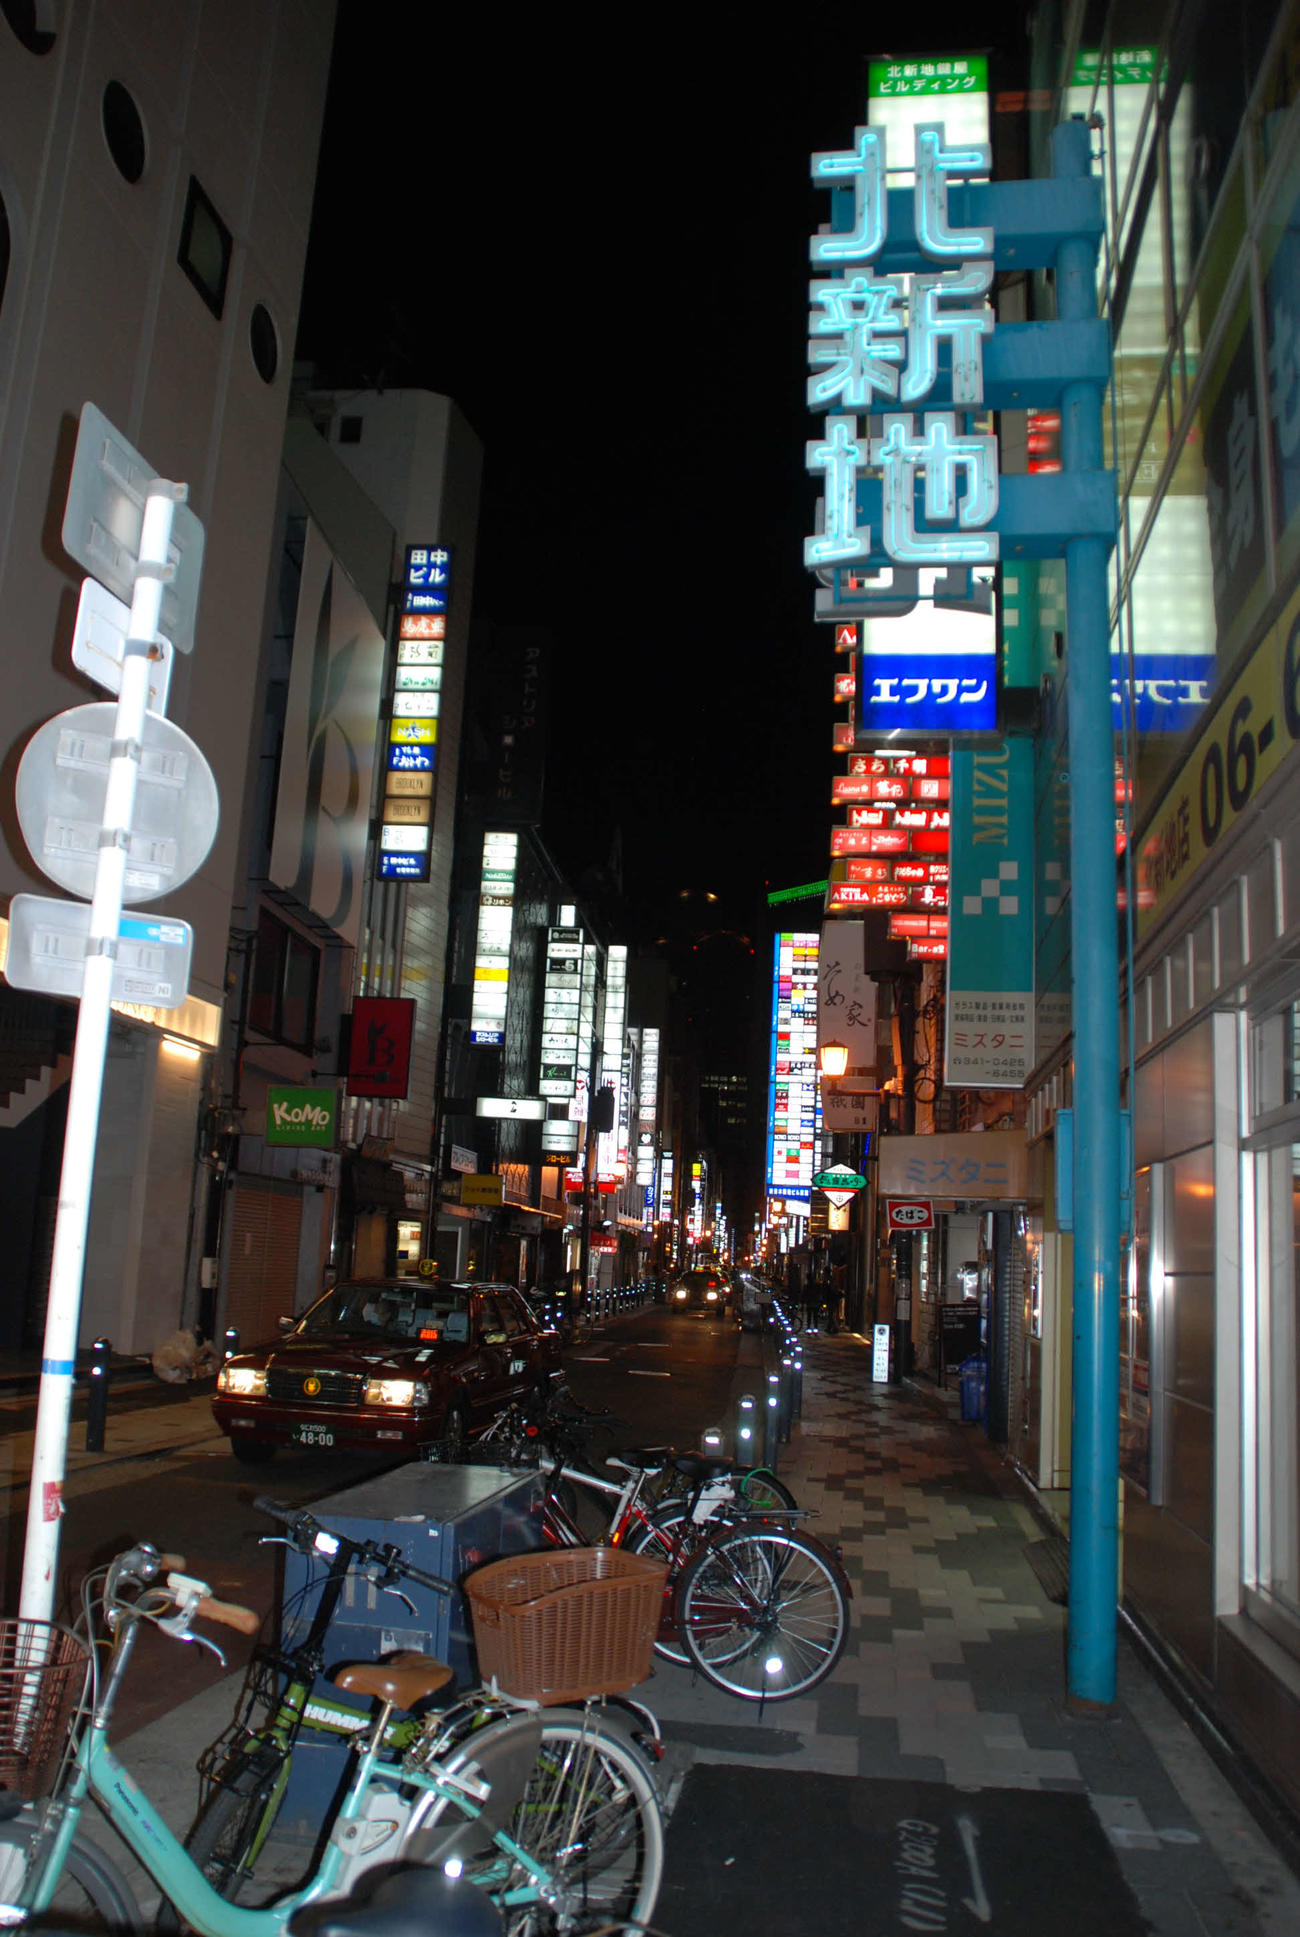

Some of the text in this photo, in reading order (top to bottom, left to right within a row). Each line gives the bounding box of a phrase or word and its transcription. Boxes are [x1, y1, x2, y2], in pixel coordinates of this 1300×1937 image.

[880, 75, 977, 92] ビルディング
[804, 121, 999, 568] 北新地
[411, 548, 448, 566] 田中
[409, 567, 445, 584] ビル
[870, 678, 987, 704] エフワン
[395, 775, 424, 790] BROOKLYN
[832, 892, 869, 901] AKIRA
[954, 1032, 1025, 1048] ミズタニ
[907, 1157, 1009, 1185] ミズタニ
[895, 1209, 925, 1221] たばこ
